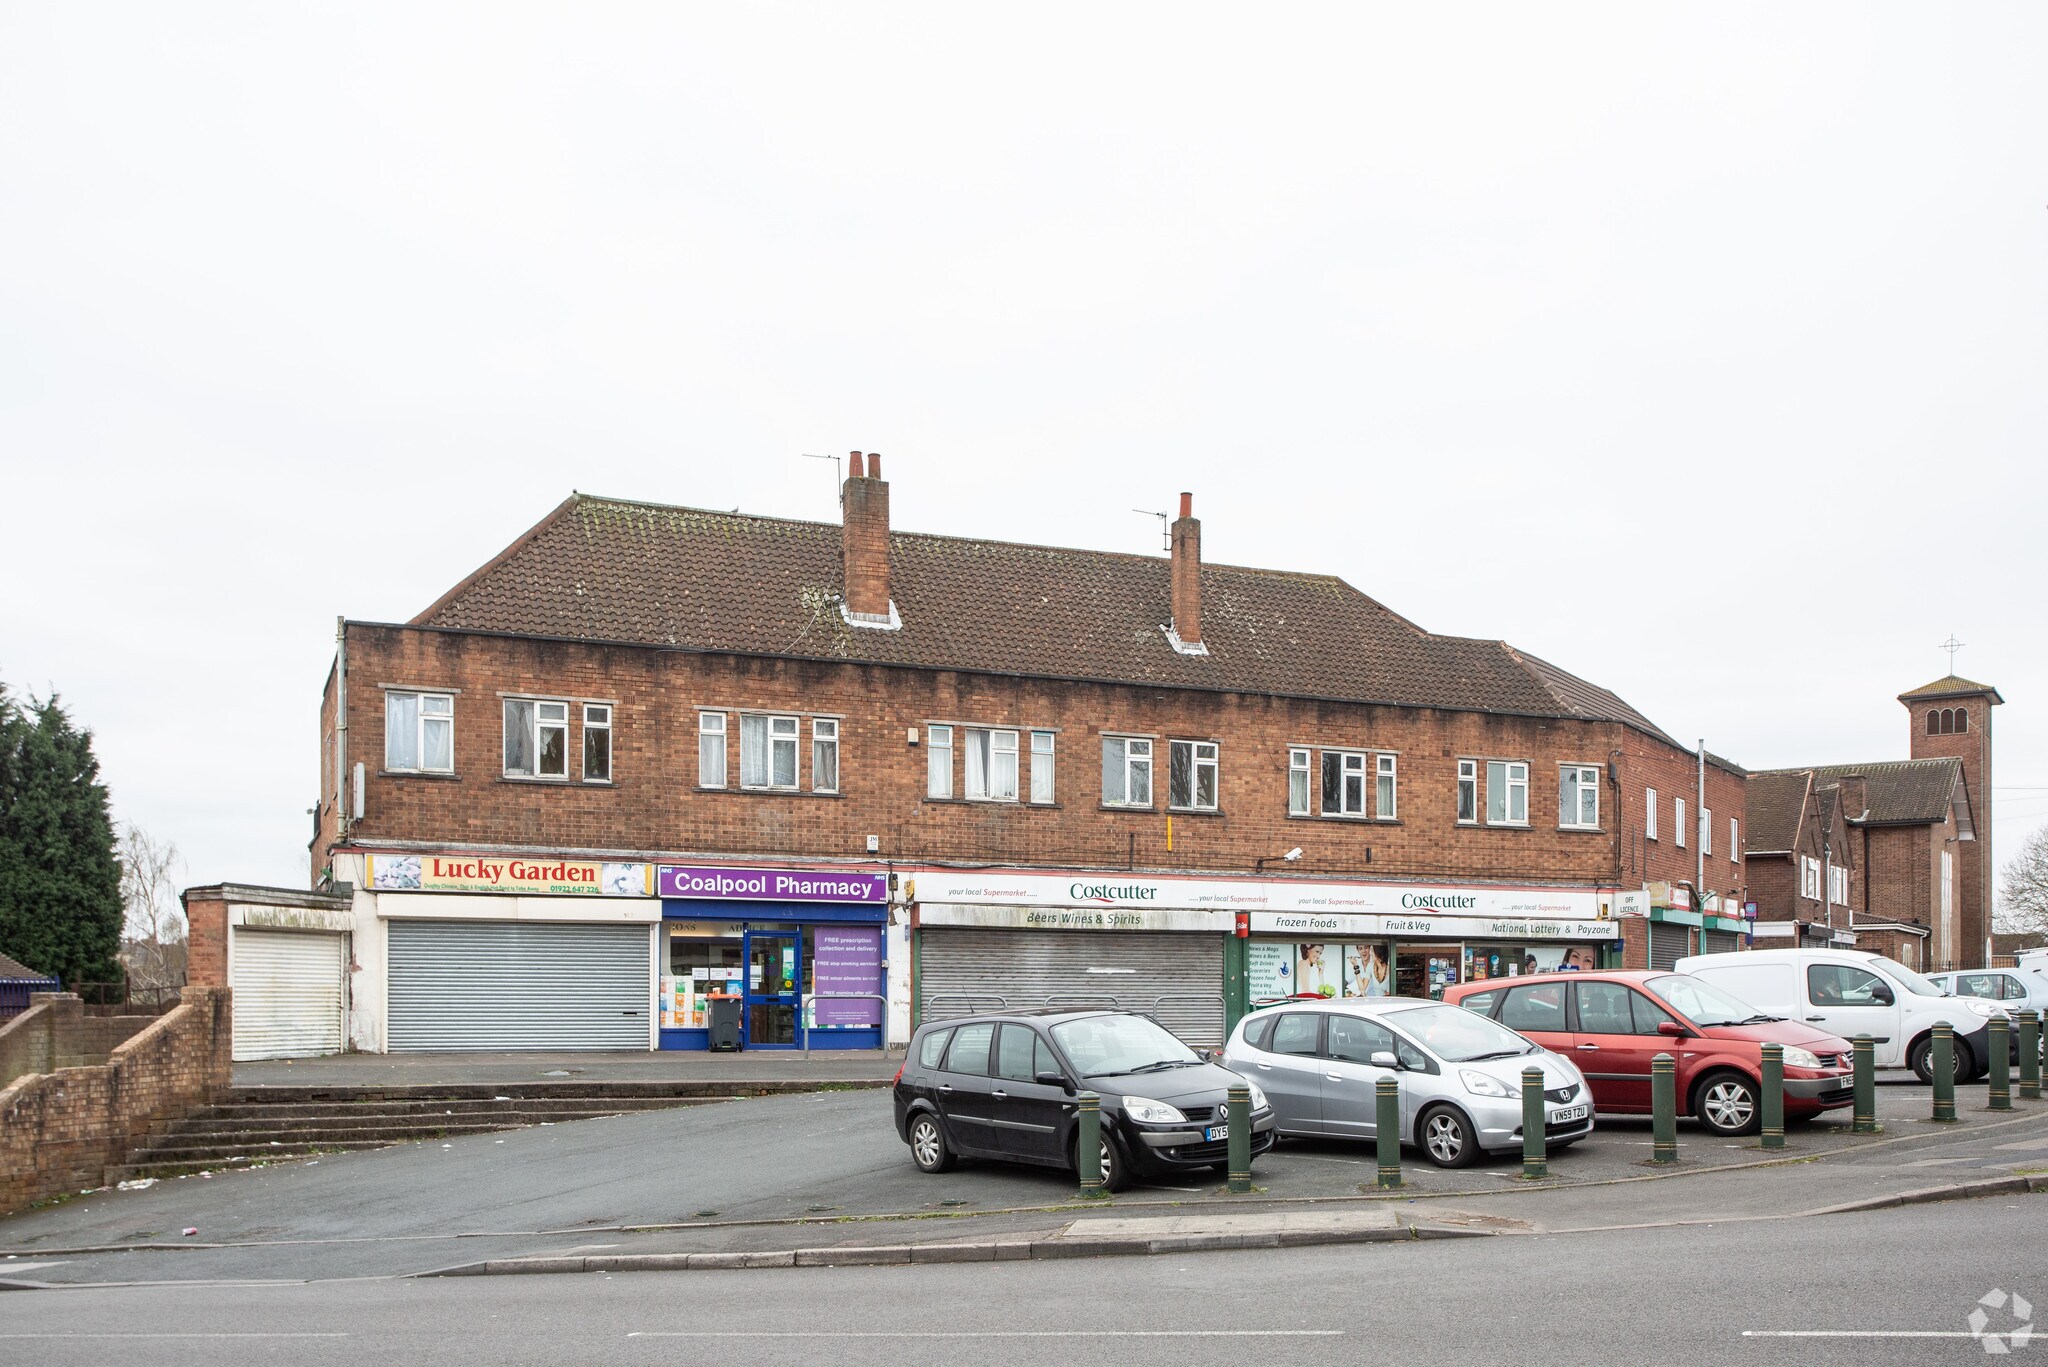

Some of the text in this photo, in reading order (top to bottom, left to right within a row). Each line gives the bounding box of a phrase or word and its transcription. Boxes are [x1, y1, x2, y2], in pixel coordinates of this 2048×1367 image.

[433, 858, 596, 885] Lucky Garden
[550, 885, 571, 893] 01922
[674, 873, 872, 899] Coalpool Pharmacy
[948, 888, 964, 896] your
[965, 888, 982, 896] local
[1070, 882, 1158, 900] Costcutter
[1213, 894, 1229, 902] local
[1229, 895, 1269, 904] Supermarket
[1312, 897, 1327, 905] local
[1401, 893, 1476, 909] Costcutter
[1524, 903, 1537, 911] local
[1537, 904, 1572, 912] Supermarket
[1027, 912, 1141, 926] Beers Wines & Spirits
[1276, 917, 1338, 928] Frozen Foods
[728, 923, 765, 932] ADICE
[1386, 920, 1431, 933] Fruit & Veg
[1491, 923, 1611, 936] National Lottery & Payzone
[1554, 1107, 1585, 1121] VN59 TZU
[1210, 1126, 1228, 1139] DY5
